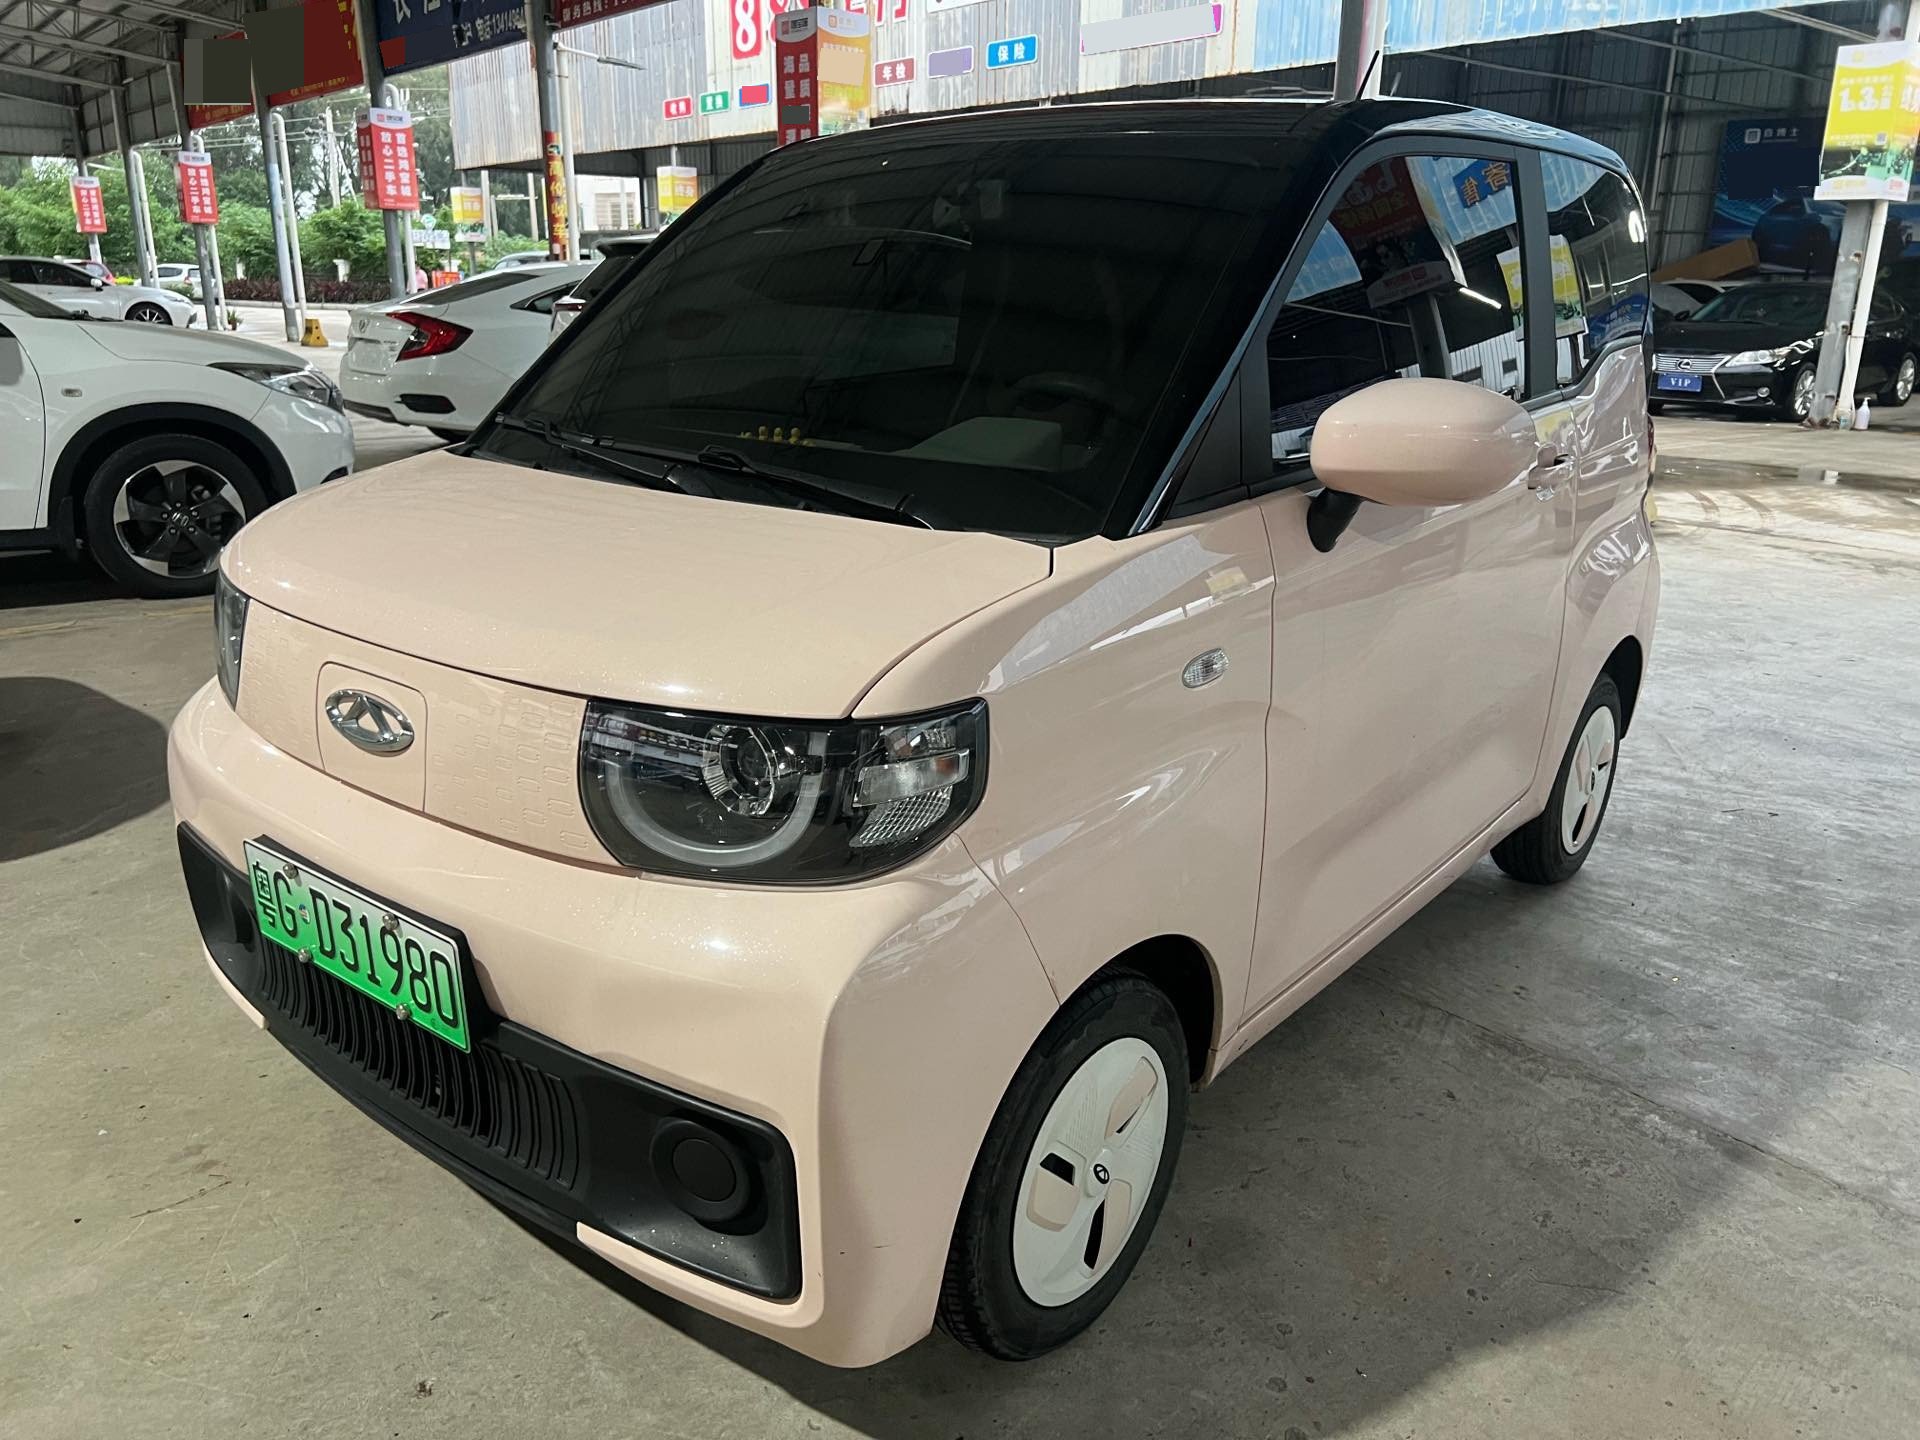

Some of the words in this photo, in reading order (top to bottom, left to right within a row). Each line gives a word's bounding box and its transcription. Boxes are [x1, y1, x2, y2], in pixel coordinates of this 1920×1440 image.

[998, 42, 1025, 62] 保险
[882, 63, 906, 80] 年检
[381, 131, 397, 196] 放心二手车
[1670, 377, 1691, 387] VIP
